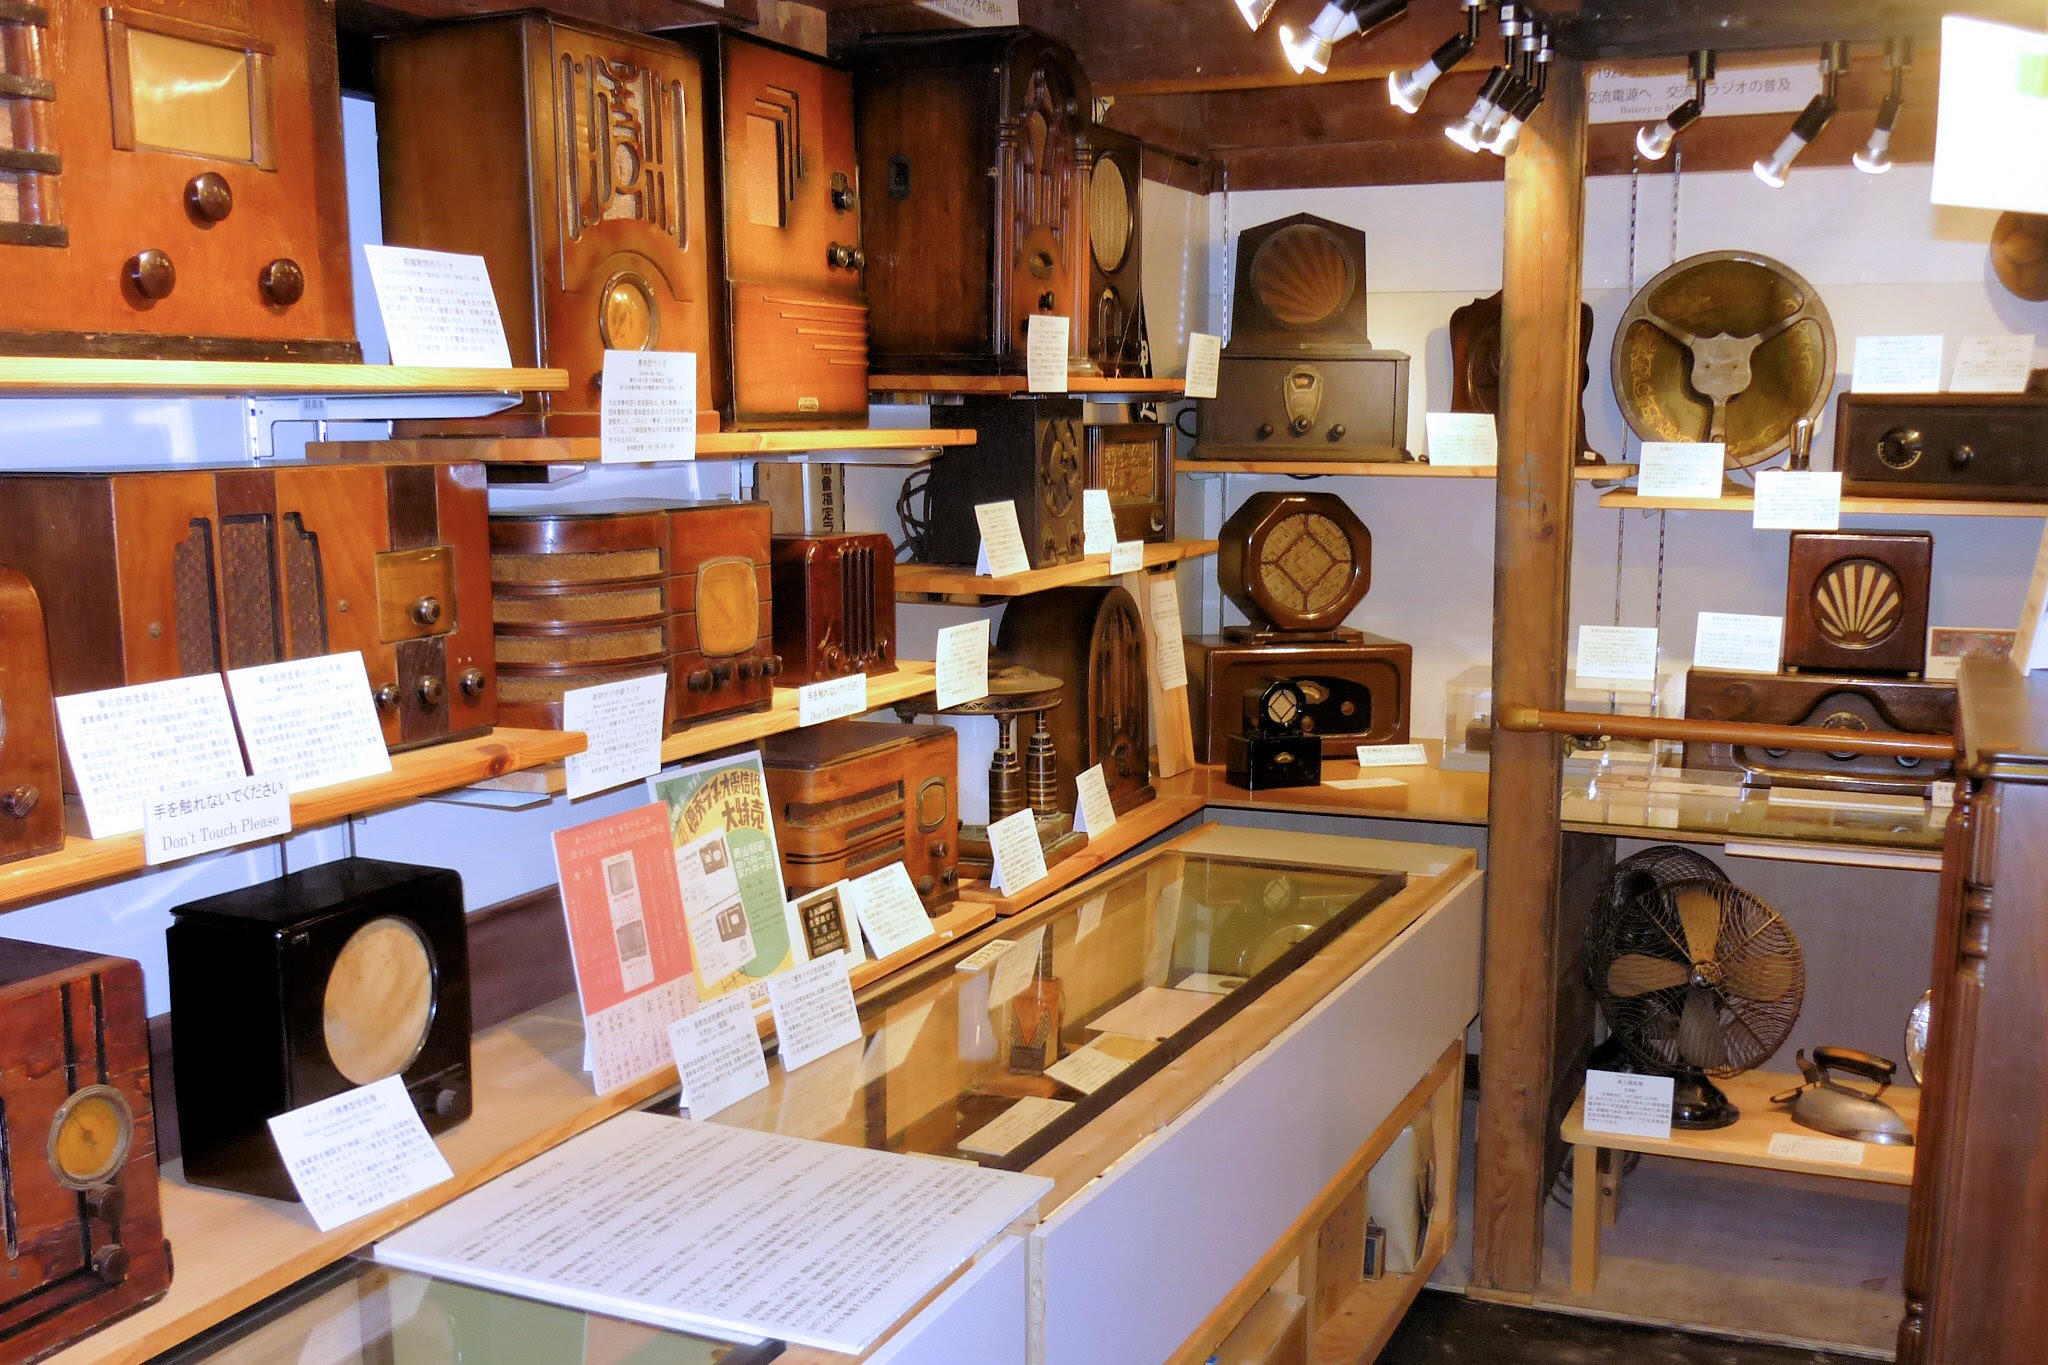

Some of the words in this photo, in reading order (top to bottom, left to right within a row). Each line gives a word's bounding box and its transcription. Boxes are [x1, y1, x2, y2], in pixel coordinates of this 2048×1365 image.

[1665, 78, 1792, 99] 交流ラジオの普及
[1620, 105, 1651, 115] Battery
[1654, 104, 1663, 112] to
[153, 781, 284, 820] 手を触れないでください
[162, 832, 196, 851] Don't
[200, 822, 238, 842] Touch
[241, 815, 280, 832] Please
